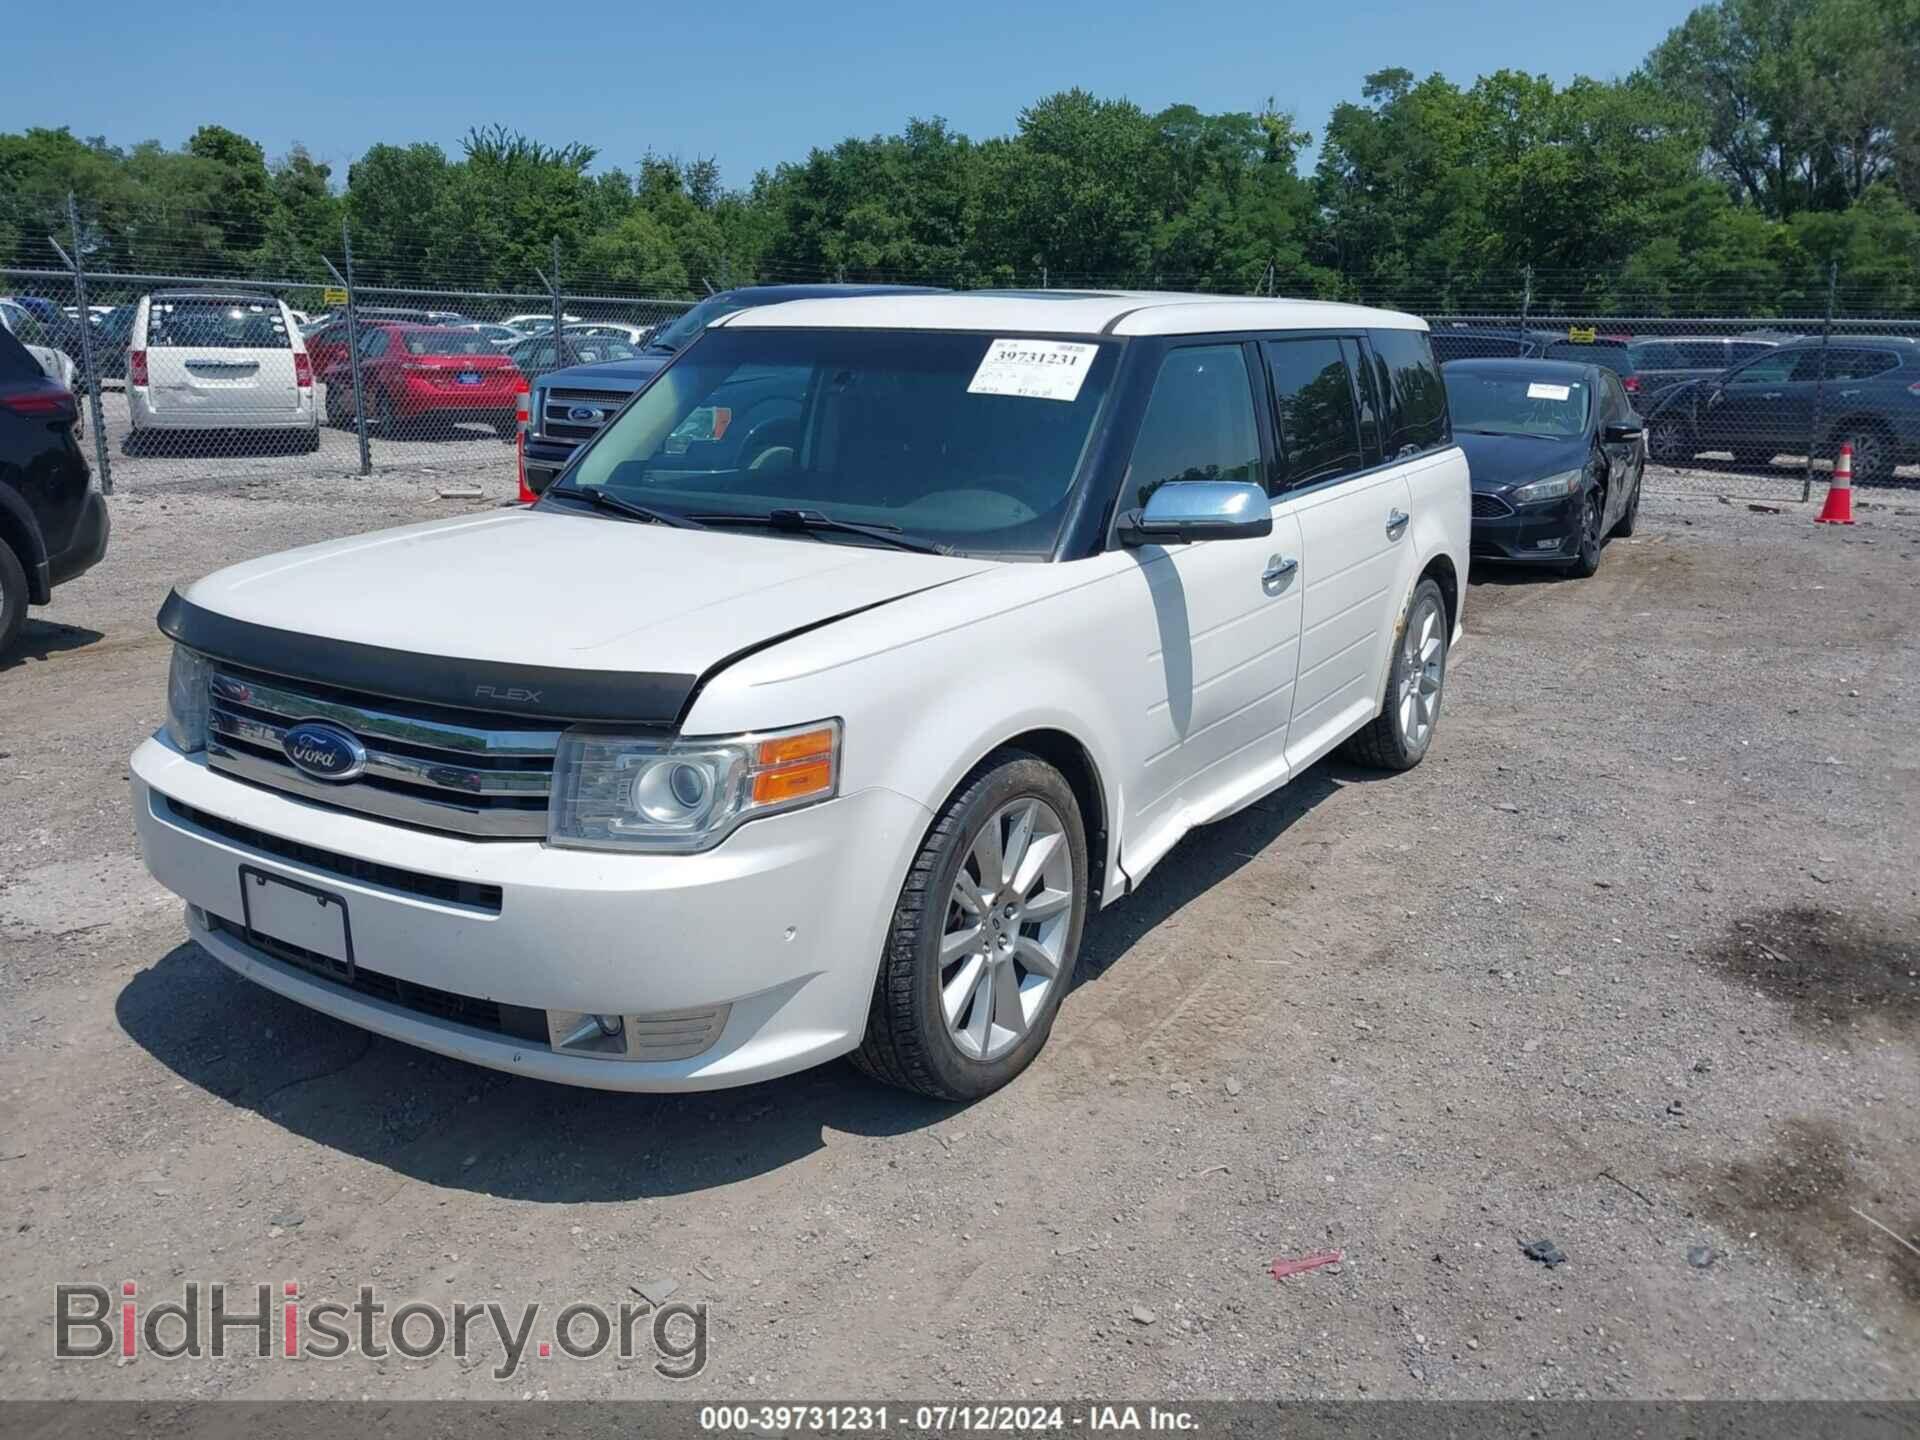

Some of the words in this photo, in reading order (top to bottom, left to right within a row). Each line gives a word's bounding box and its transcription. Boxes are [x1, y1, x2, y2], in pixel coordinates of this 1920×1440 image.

[994, 350, 1078, 366] 39731231
[474, 685, 544, 703] FLEX
[293, 733, 337, 768] Ford
